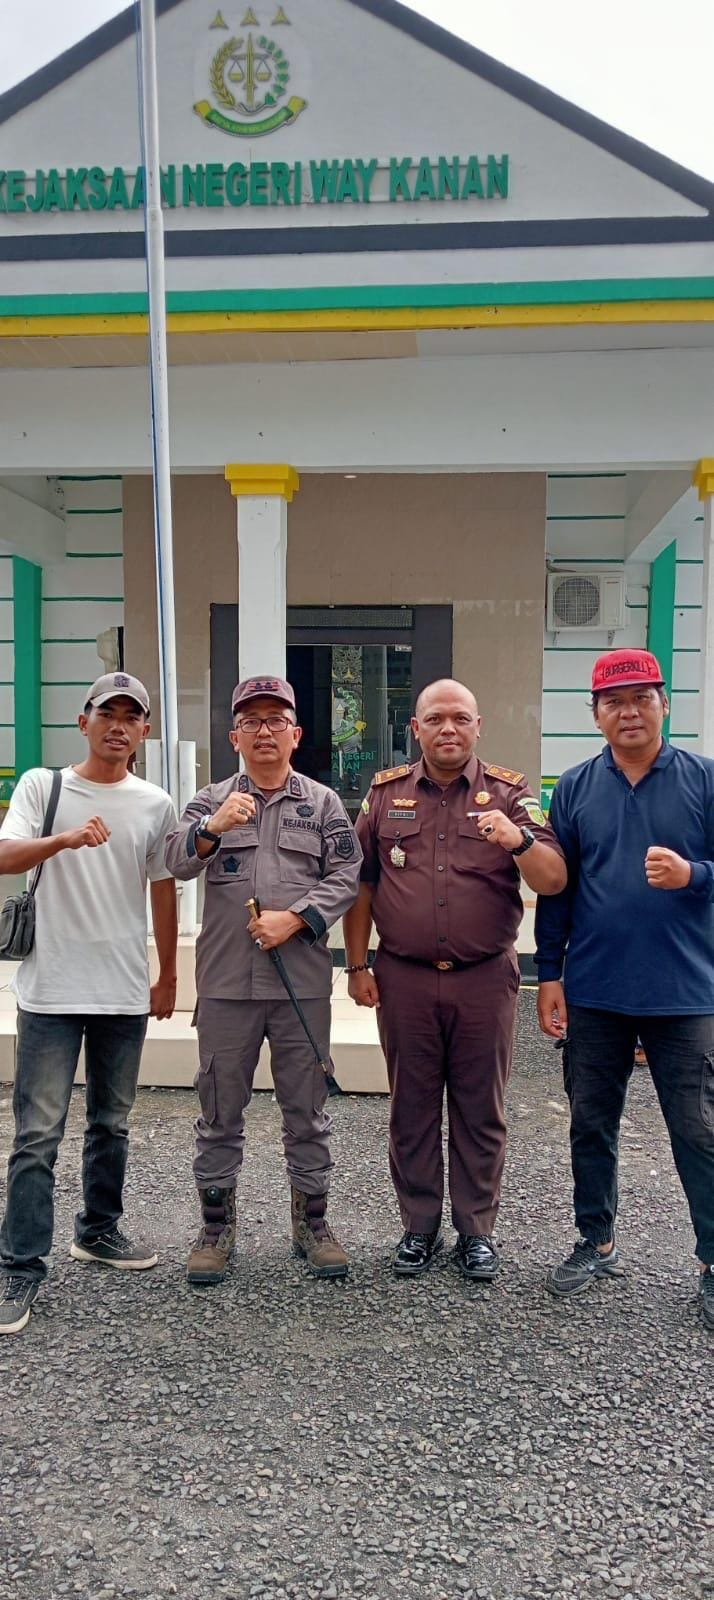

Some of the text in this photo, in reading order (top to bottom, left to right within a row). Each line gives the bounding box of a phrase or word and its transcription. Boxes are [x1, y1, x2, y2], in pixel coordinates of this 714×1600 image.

[182, 161, 302, 207] NEGERI
[309, 158, 378, 204] WAY
[389, 154, 509, 202] KANAN
